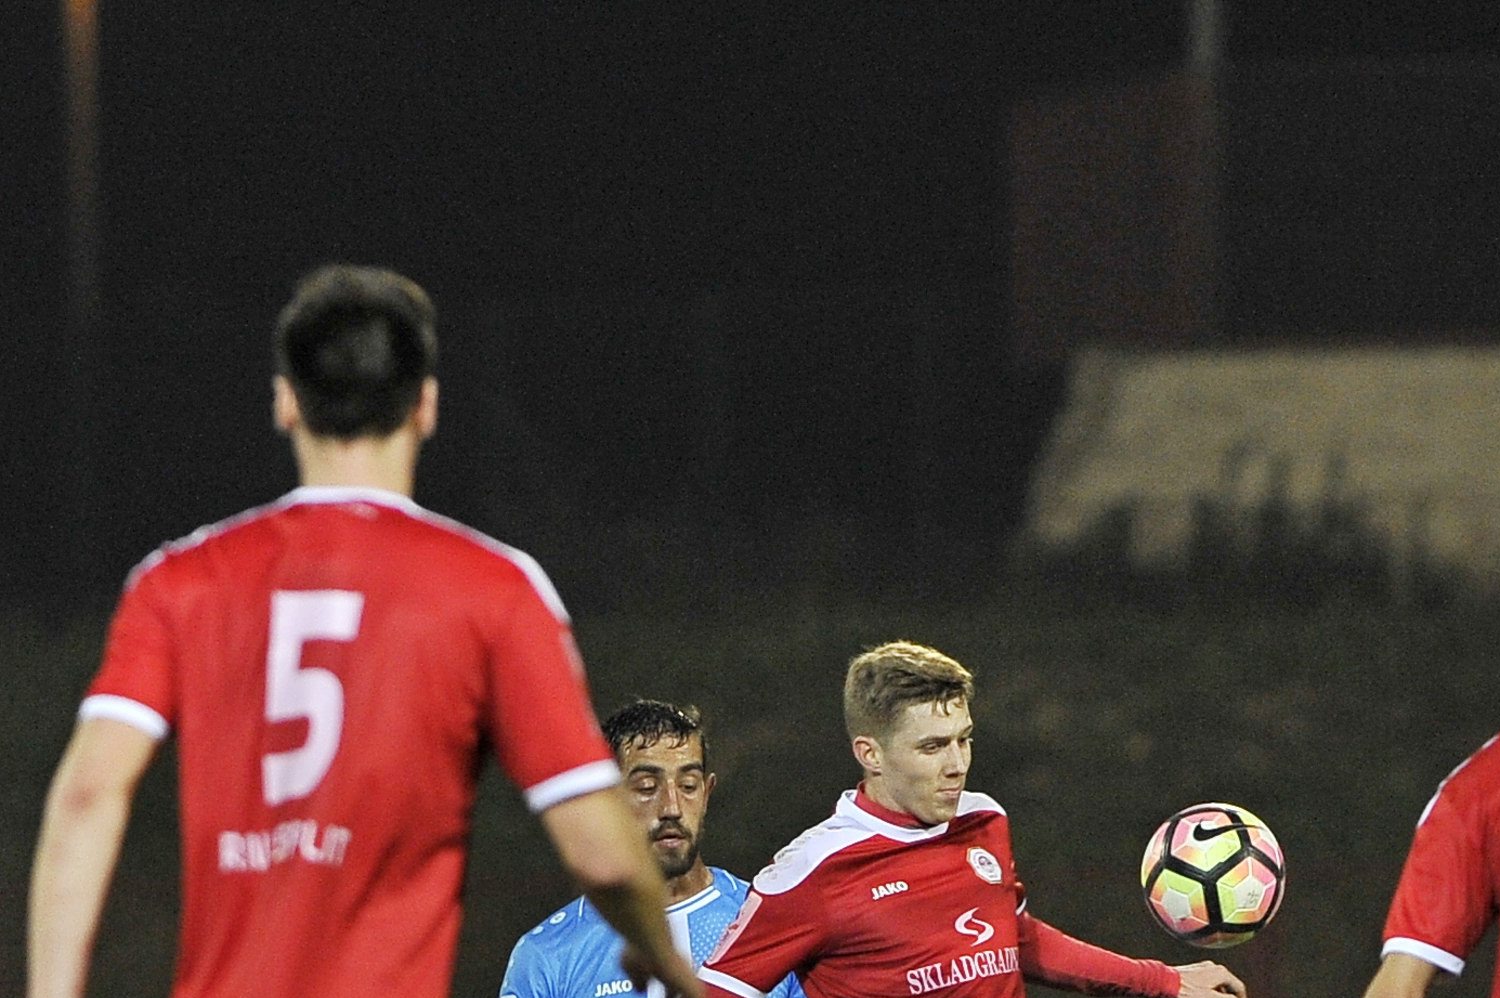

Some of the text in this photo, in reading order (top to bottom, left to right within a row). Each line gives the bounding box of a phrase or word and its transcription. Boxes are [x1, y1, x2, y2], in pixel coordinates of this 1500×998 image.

[261, 589, 365, 806] 5
[871, 880, 909, 901] JAKO
[594, 979, 633, 998] JAKO
